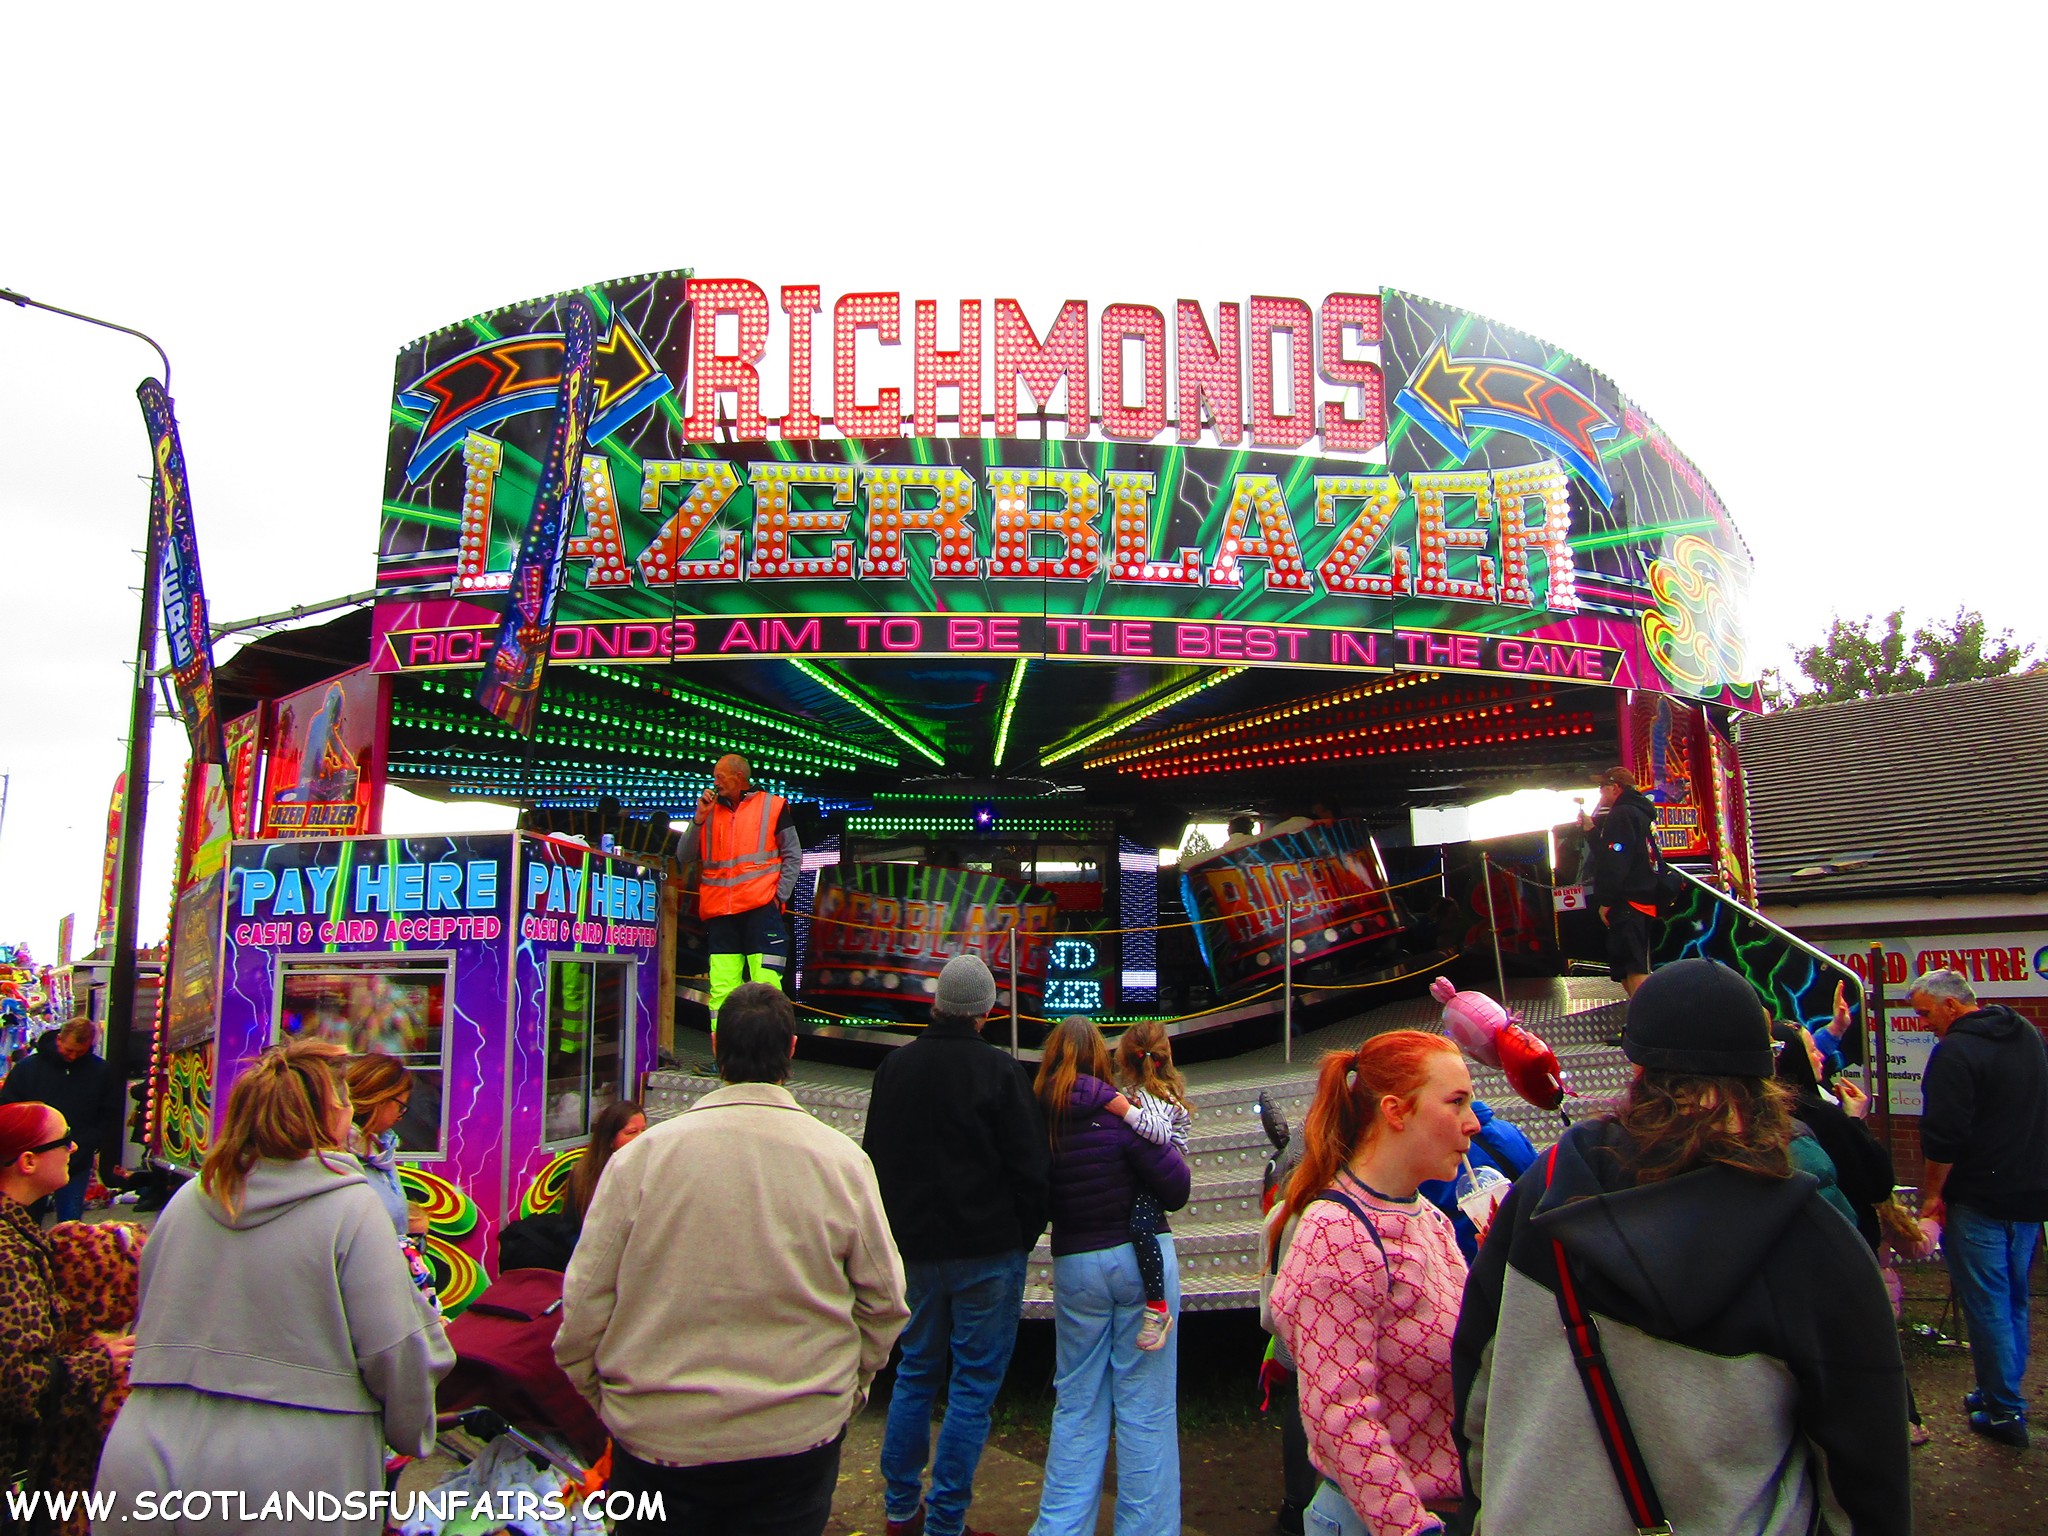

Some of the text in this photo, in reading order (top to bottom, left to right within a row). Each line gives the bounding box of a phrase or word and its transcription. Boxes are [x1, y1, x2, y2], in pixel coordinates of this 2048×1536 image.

[683, 277, 1387, 454] RICHMONDS
[719, 618, 820, 652] AIM
[845, 618, 922, 651] TO
[947, 617, 1022, 650] BE
[1045, 620, 1152, 655] THE
[1176, 624, 1309, 662] BEST
[1331, 632, 1377, 665] IN
[1397, 631, 1480, 667] THE
[1497, 641, 1603, 679] GAME
[268, 803, 360, 828] LAZER BLAZER
[1666, 806, 1698, 827] BLAZER
[241, 860, 498, 917] PAY HERE
[527, 862, 657, 922] PAY HERE
[235, 916, 502, 947] CASH & CARD ACCEPTED
[524, 917, 658, 948] CASH & CARD ACCEPTED
[1917, 946, 2029, 982] CENTRE
